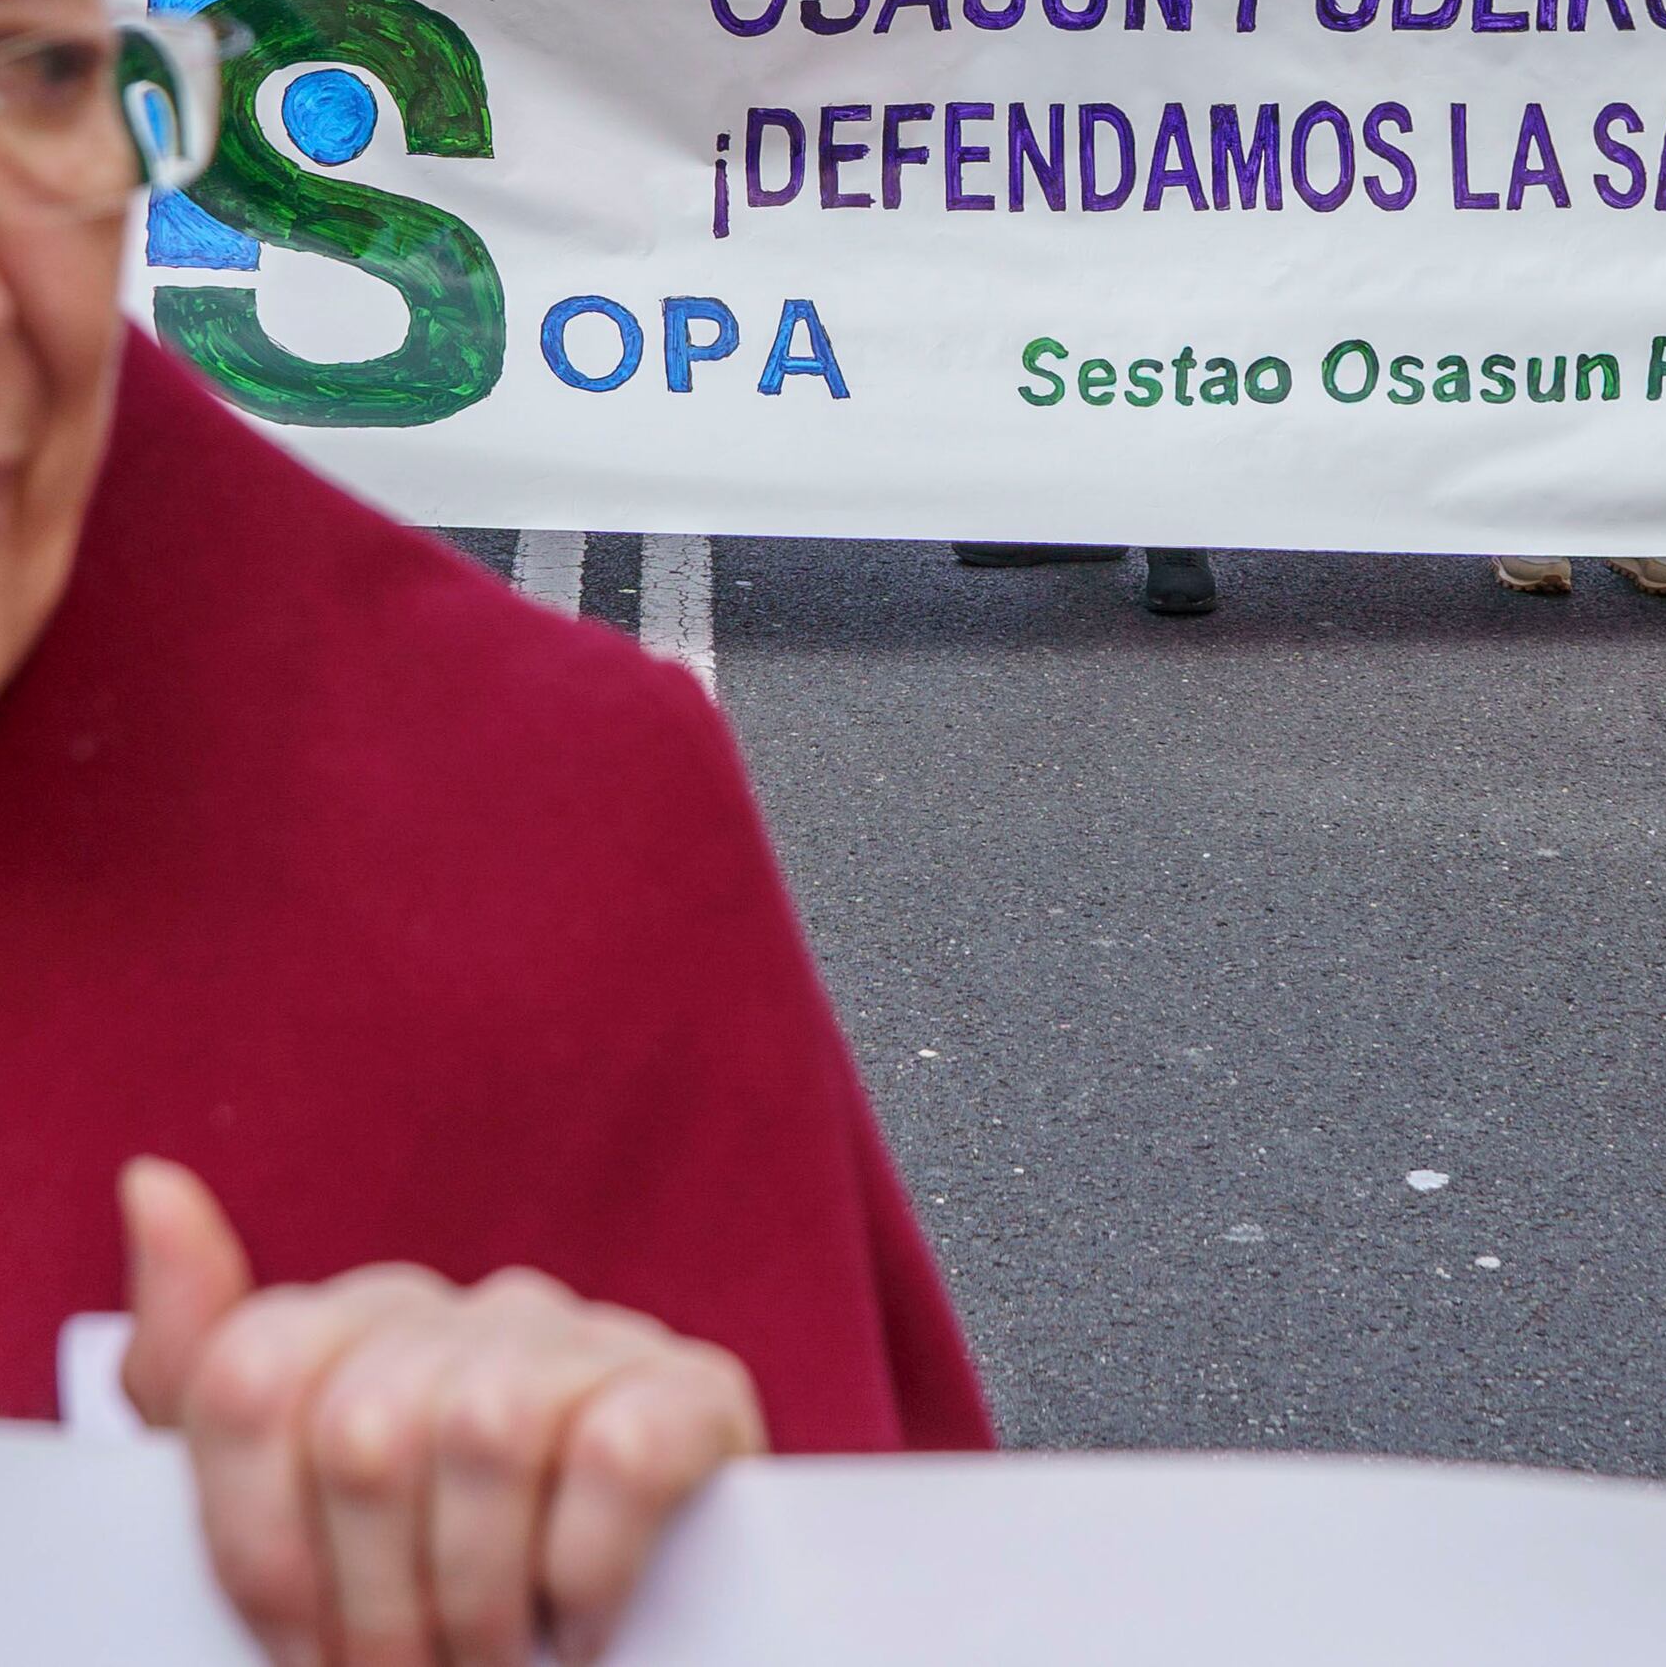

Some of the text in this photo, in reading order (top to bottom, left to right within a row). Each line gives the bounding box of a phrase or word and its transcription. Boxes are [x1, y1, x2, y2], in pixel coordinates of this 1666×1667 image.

[712, 95, 1417, 239] ¡DEFENDAMOS
[1451, 102, 1571, 211] LA
[1017, 335, 1292, 409] Sestao
[1320, 339, 1622, 406] Osasun
